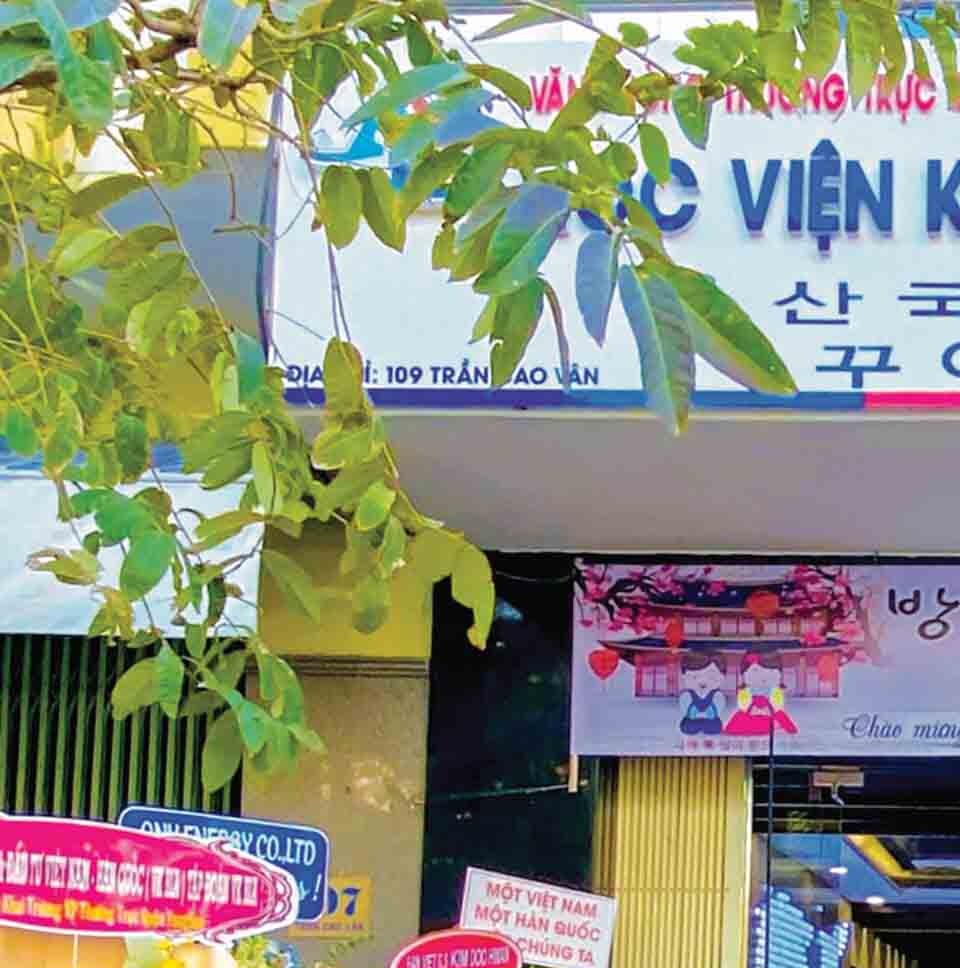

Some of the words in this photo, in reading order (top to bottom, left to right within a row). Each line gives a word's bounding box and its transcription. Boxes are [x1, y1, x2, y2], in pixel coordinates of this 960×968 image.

[731, 138, 894, 254] VIỆN
[387, 366, 422, 384] 109
[508, 366, 547, 385] AO
[486, 881, 523, 904] MỘT
[526, 890, 559, 912] VIỆT
[562, 898, 598, 918] NAM
[474, 903, 512, 926] MỘT
[515, 911, 550, 932] HÀN
[554, 919, 601, 941] QUỐC
[576, 949, 595, 964] TA
